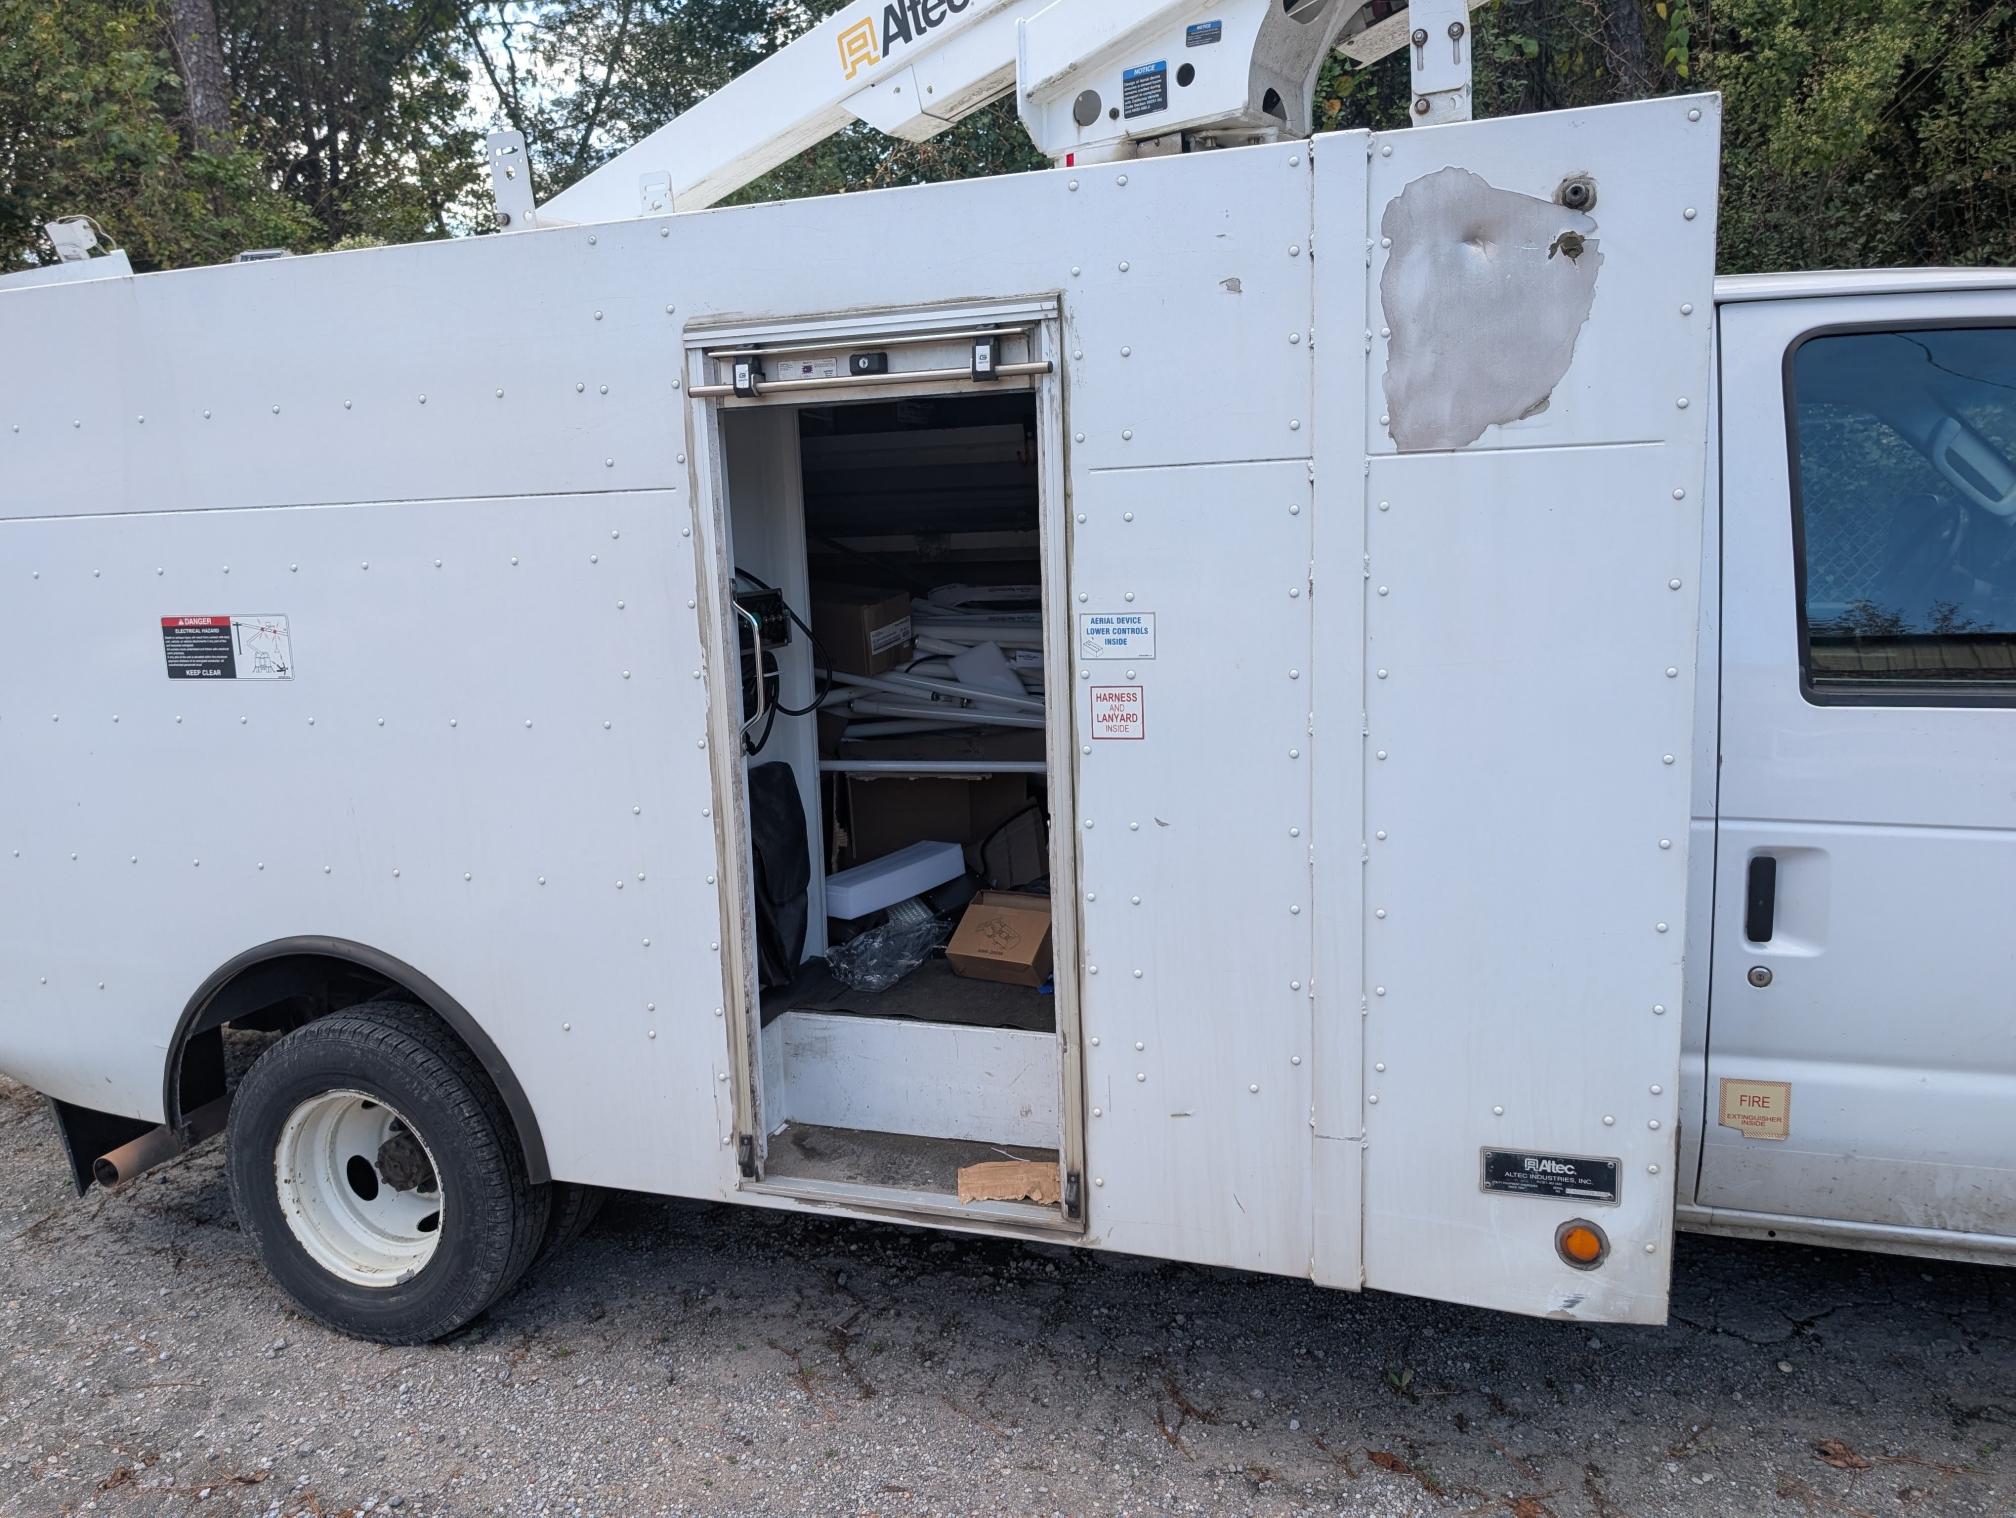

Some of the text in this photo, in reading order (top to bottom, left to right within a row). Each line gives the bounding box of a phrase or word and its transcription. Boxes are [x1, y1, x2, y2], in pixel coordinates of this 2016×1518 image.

[1134, 65, 1156, 75] NOTICE
[1090, 616, 1142, 625] AERIAL DEVICE
[1086, 627, 1148, 635] LOWER CONTROLS
[1095, 692, 1138, 703] HARNESS
[1109, 704, 1125, 712] AND
[1097, 713, 1138, 723] LANYARD
[1105, 724, 1130, 733] INSIDE
[1739, 1094, 1771, 1108] FIRE
[1727, 1113, 1782, 1123] EXTINGUISHER
[1504, 1171, 1528, 1179] ALTEC
[1529, 1173, 1577, 1184] INDUSTRIES,
[1578, 1178, 1594, 1186] INC.
